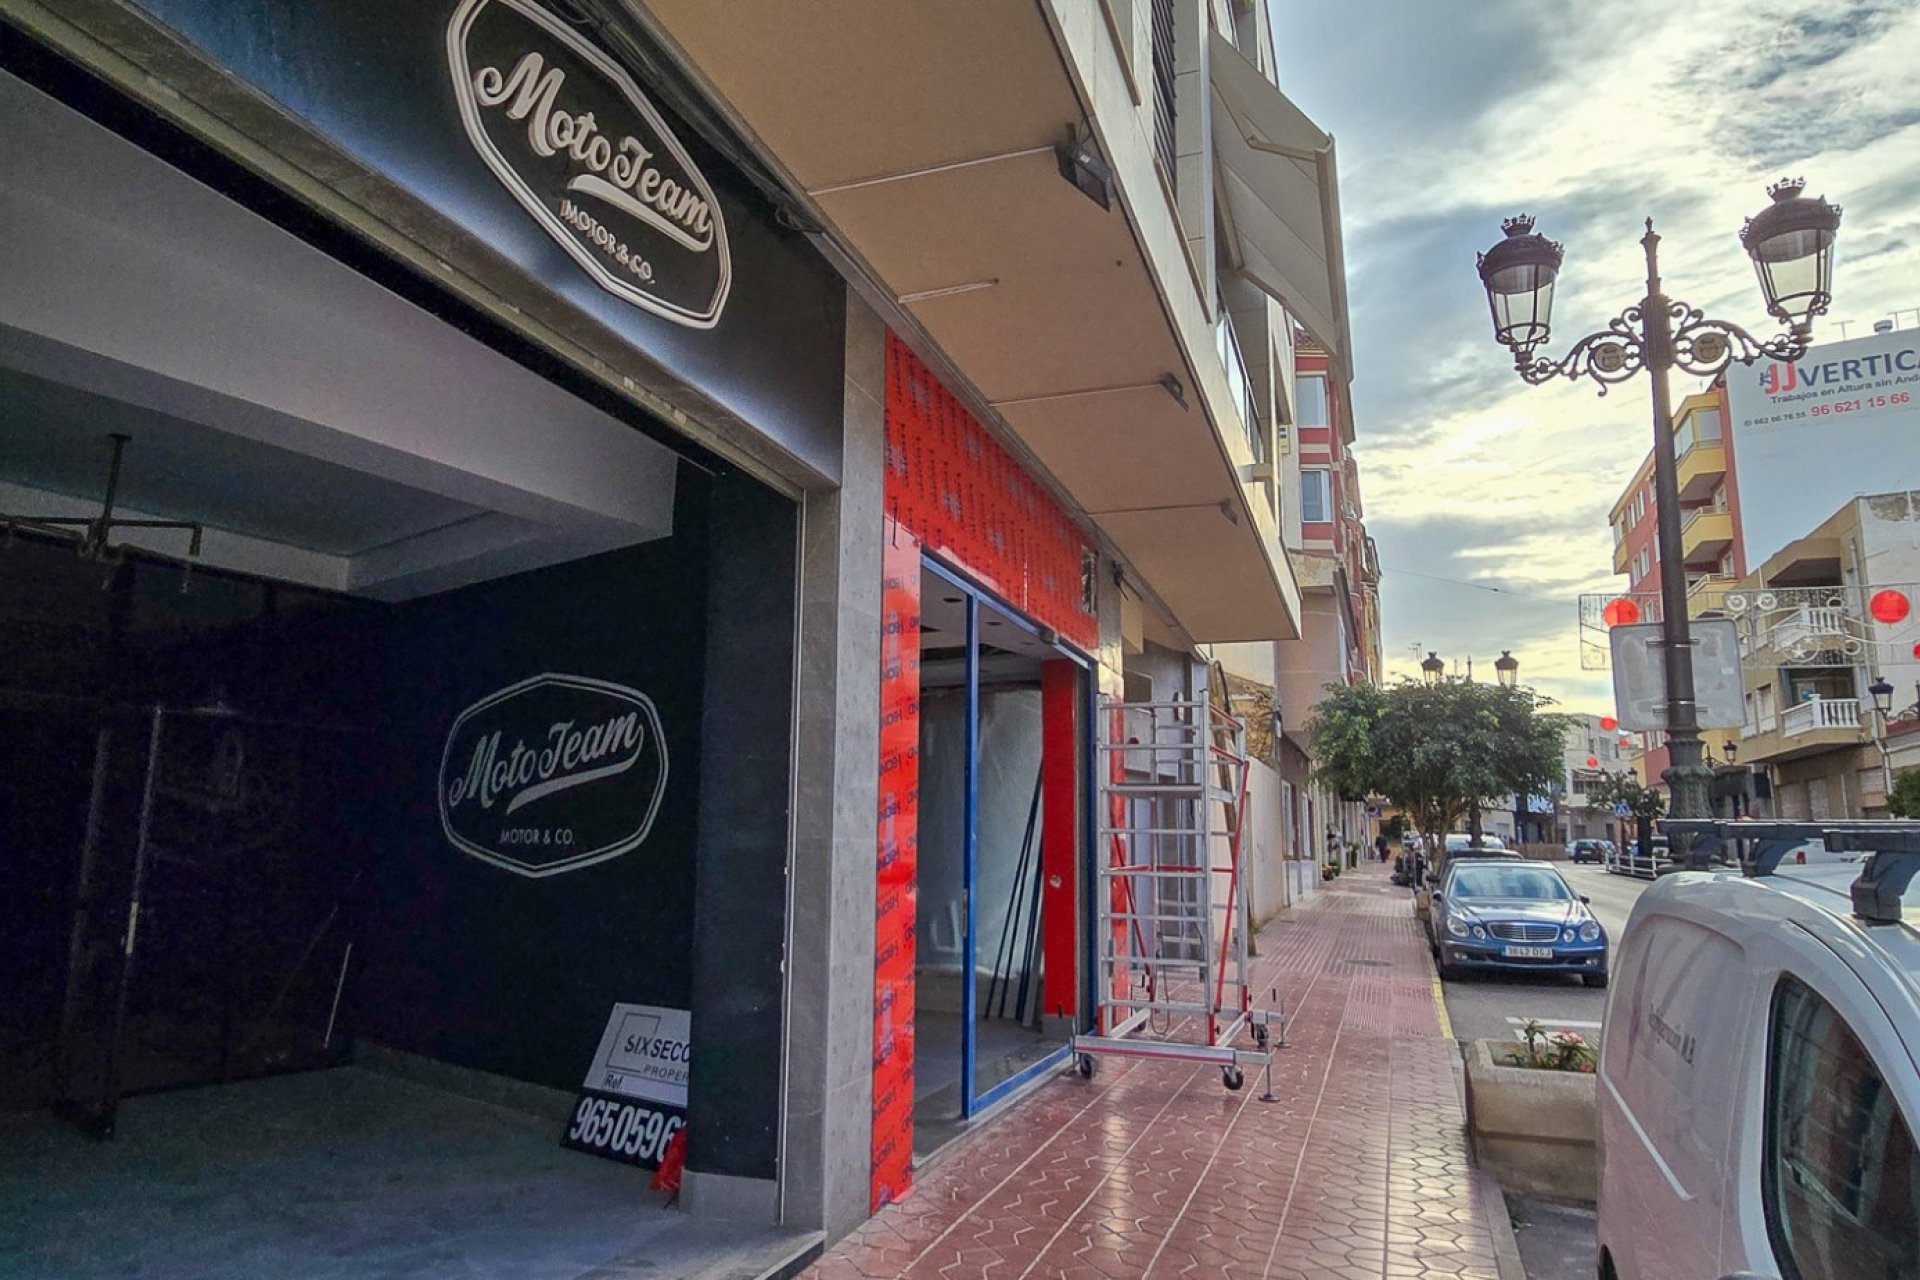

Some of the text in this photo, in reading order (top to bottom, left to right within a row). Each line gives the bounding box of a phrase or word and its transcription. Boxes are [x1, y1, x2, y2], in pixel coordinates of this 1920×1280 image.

[1762, 348, 1920, 396] JJVERTIC
[1771, 390, 1818, 405] Trabajos
[1821, 387, 1835, 397] en
[1838, 380, 1873, 394] Altura
[1875, 378, 1893, 389] sin
[1810, 404, 1830, 417] 96
[1834, 399, 1862, 414] 621
[1867, 395, 1886, 408] 15
[1890, 391, 1911, 405] 66
[501, 828, 540, 846] MOTOR
[543, 828, 551, 846] &
